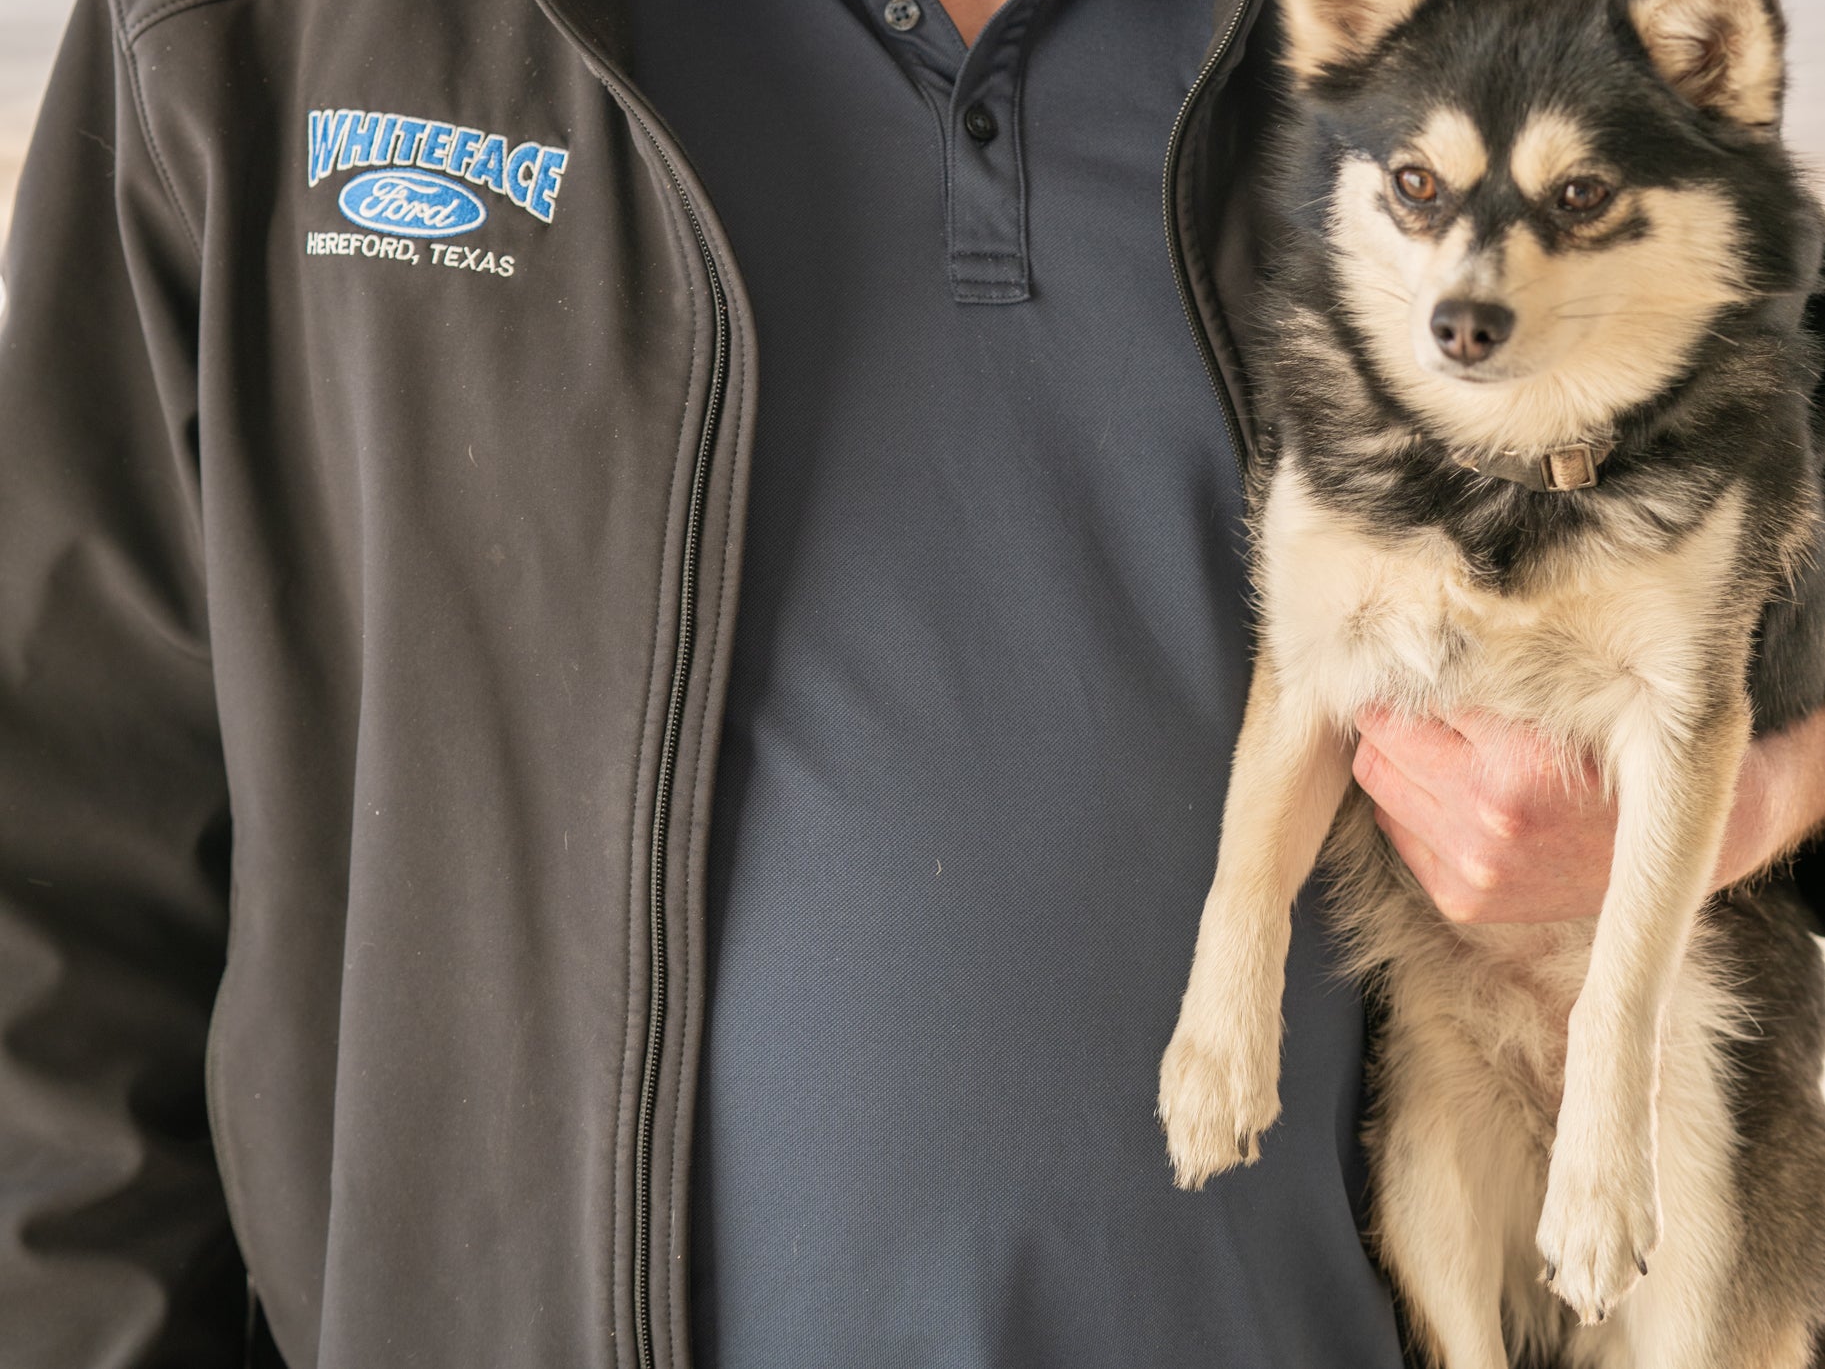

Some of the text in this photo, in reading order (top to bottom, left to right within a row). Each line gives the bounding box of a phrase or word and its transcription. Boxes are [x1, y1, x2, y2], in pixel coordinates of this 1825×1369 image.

[308, 109, 569, 223] WHITEFACE
[359, 178, 460, 228] Ford
[306, 231, 515, 277] HEREFORD, TEXAS
